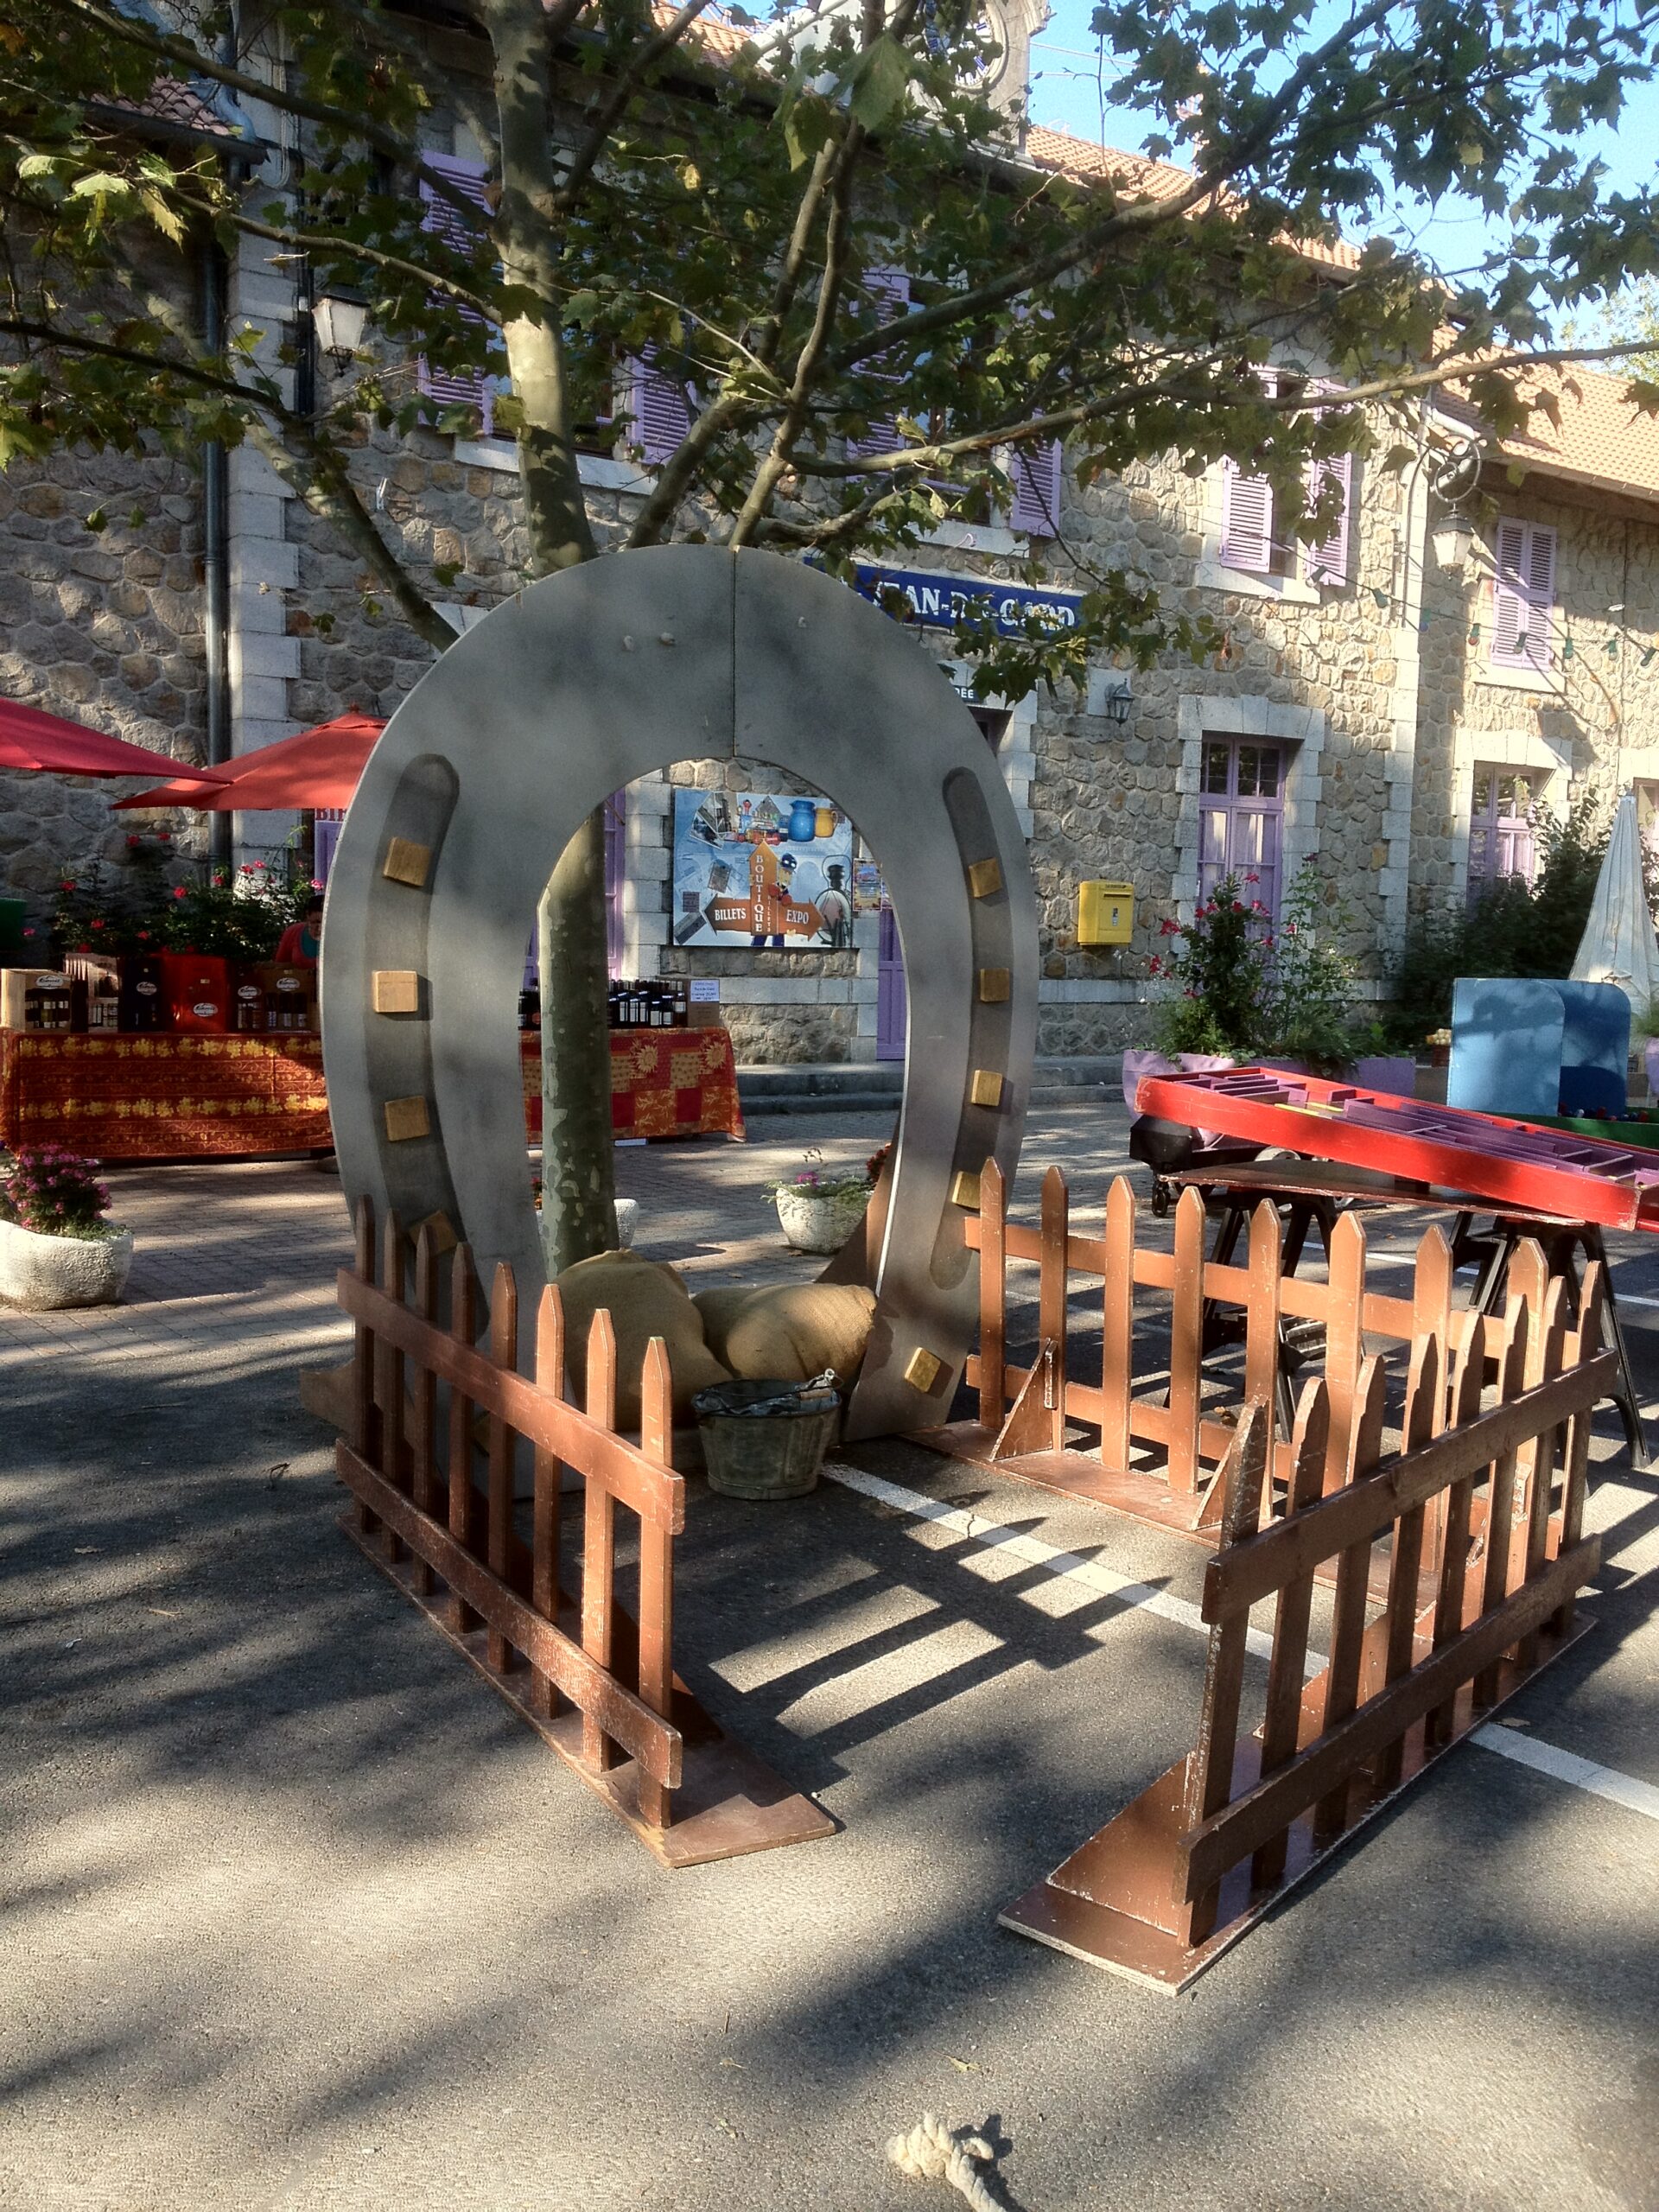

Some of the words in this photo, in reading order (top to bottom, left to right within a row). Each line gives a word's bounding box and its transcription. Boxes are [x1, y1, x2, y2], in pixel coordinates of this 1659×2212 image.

[754, 855, 764, 932] BOUTIQUE
[715, 908, 747, 921] BILLETS
[785, 909, 810, 925] EXPO
